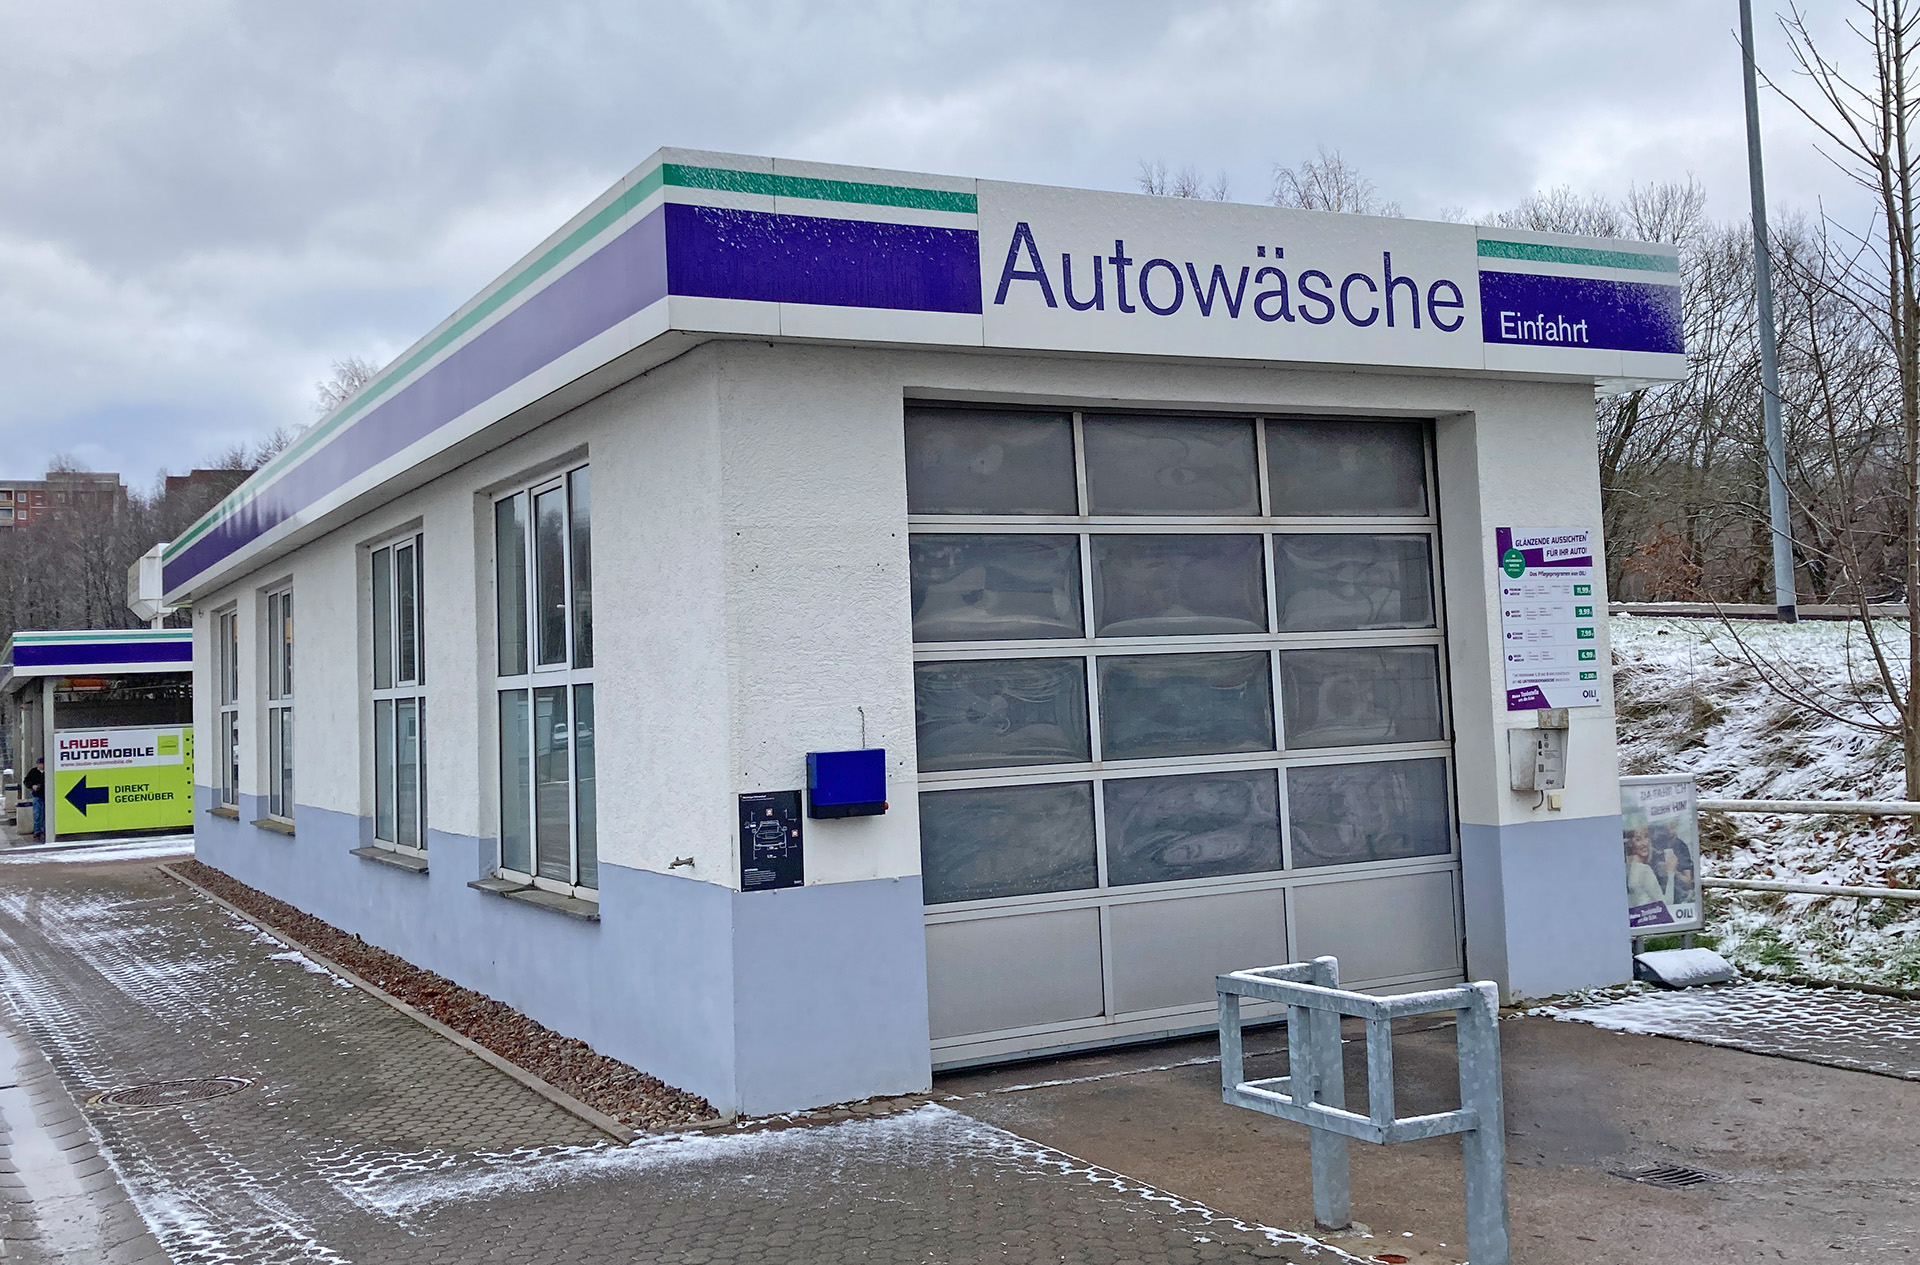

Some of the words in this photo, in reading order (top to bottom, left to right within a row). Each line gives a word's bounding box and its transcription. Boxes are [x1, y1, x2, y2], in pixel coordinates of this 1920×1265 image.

[993, 221, 1465, 333] Autowäsche
[1500, 311, 1589, 345] Einfahrt
[1515, 536, 1550, 547] GLÄNZENDE
[1551, 534, 1587, 544] AUSSICHTEN
[1546, 547, 1558, 557] FÜR
[1570, 546, 1588, 555] AUTO!
[60, 738, 109, 750] LAUBE
[60, 747, 155, 761] AUTOMOBILE
[60, 759, 133, 768] www.laube-automobile.de
[114, 784, 150, 794] DIREKT
[114, 792, 174, 804] GEGENÜBER
[1675, 908, 1694, 919] OIL!
